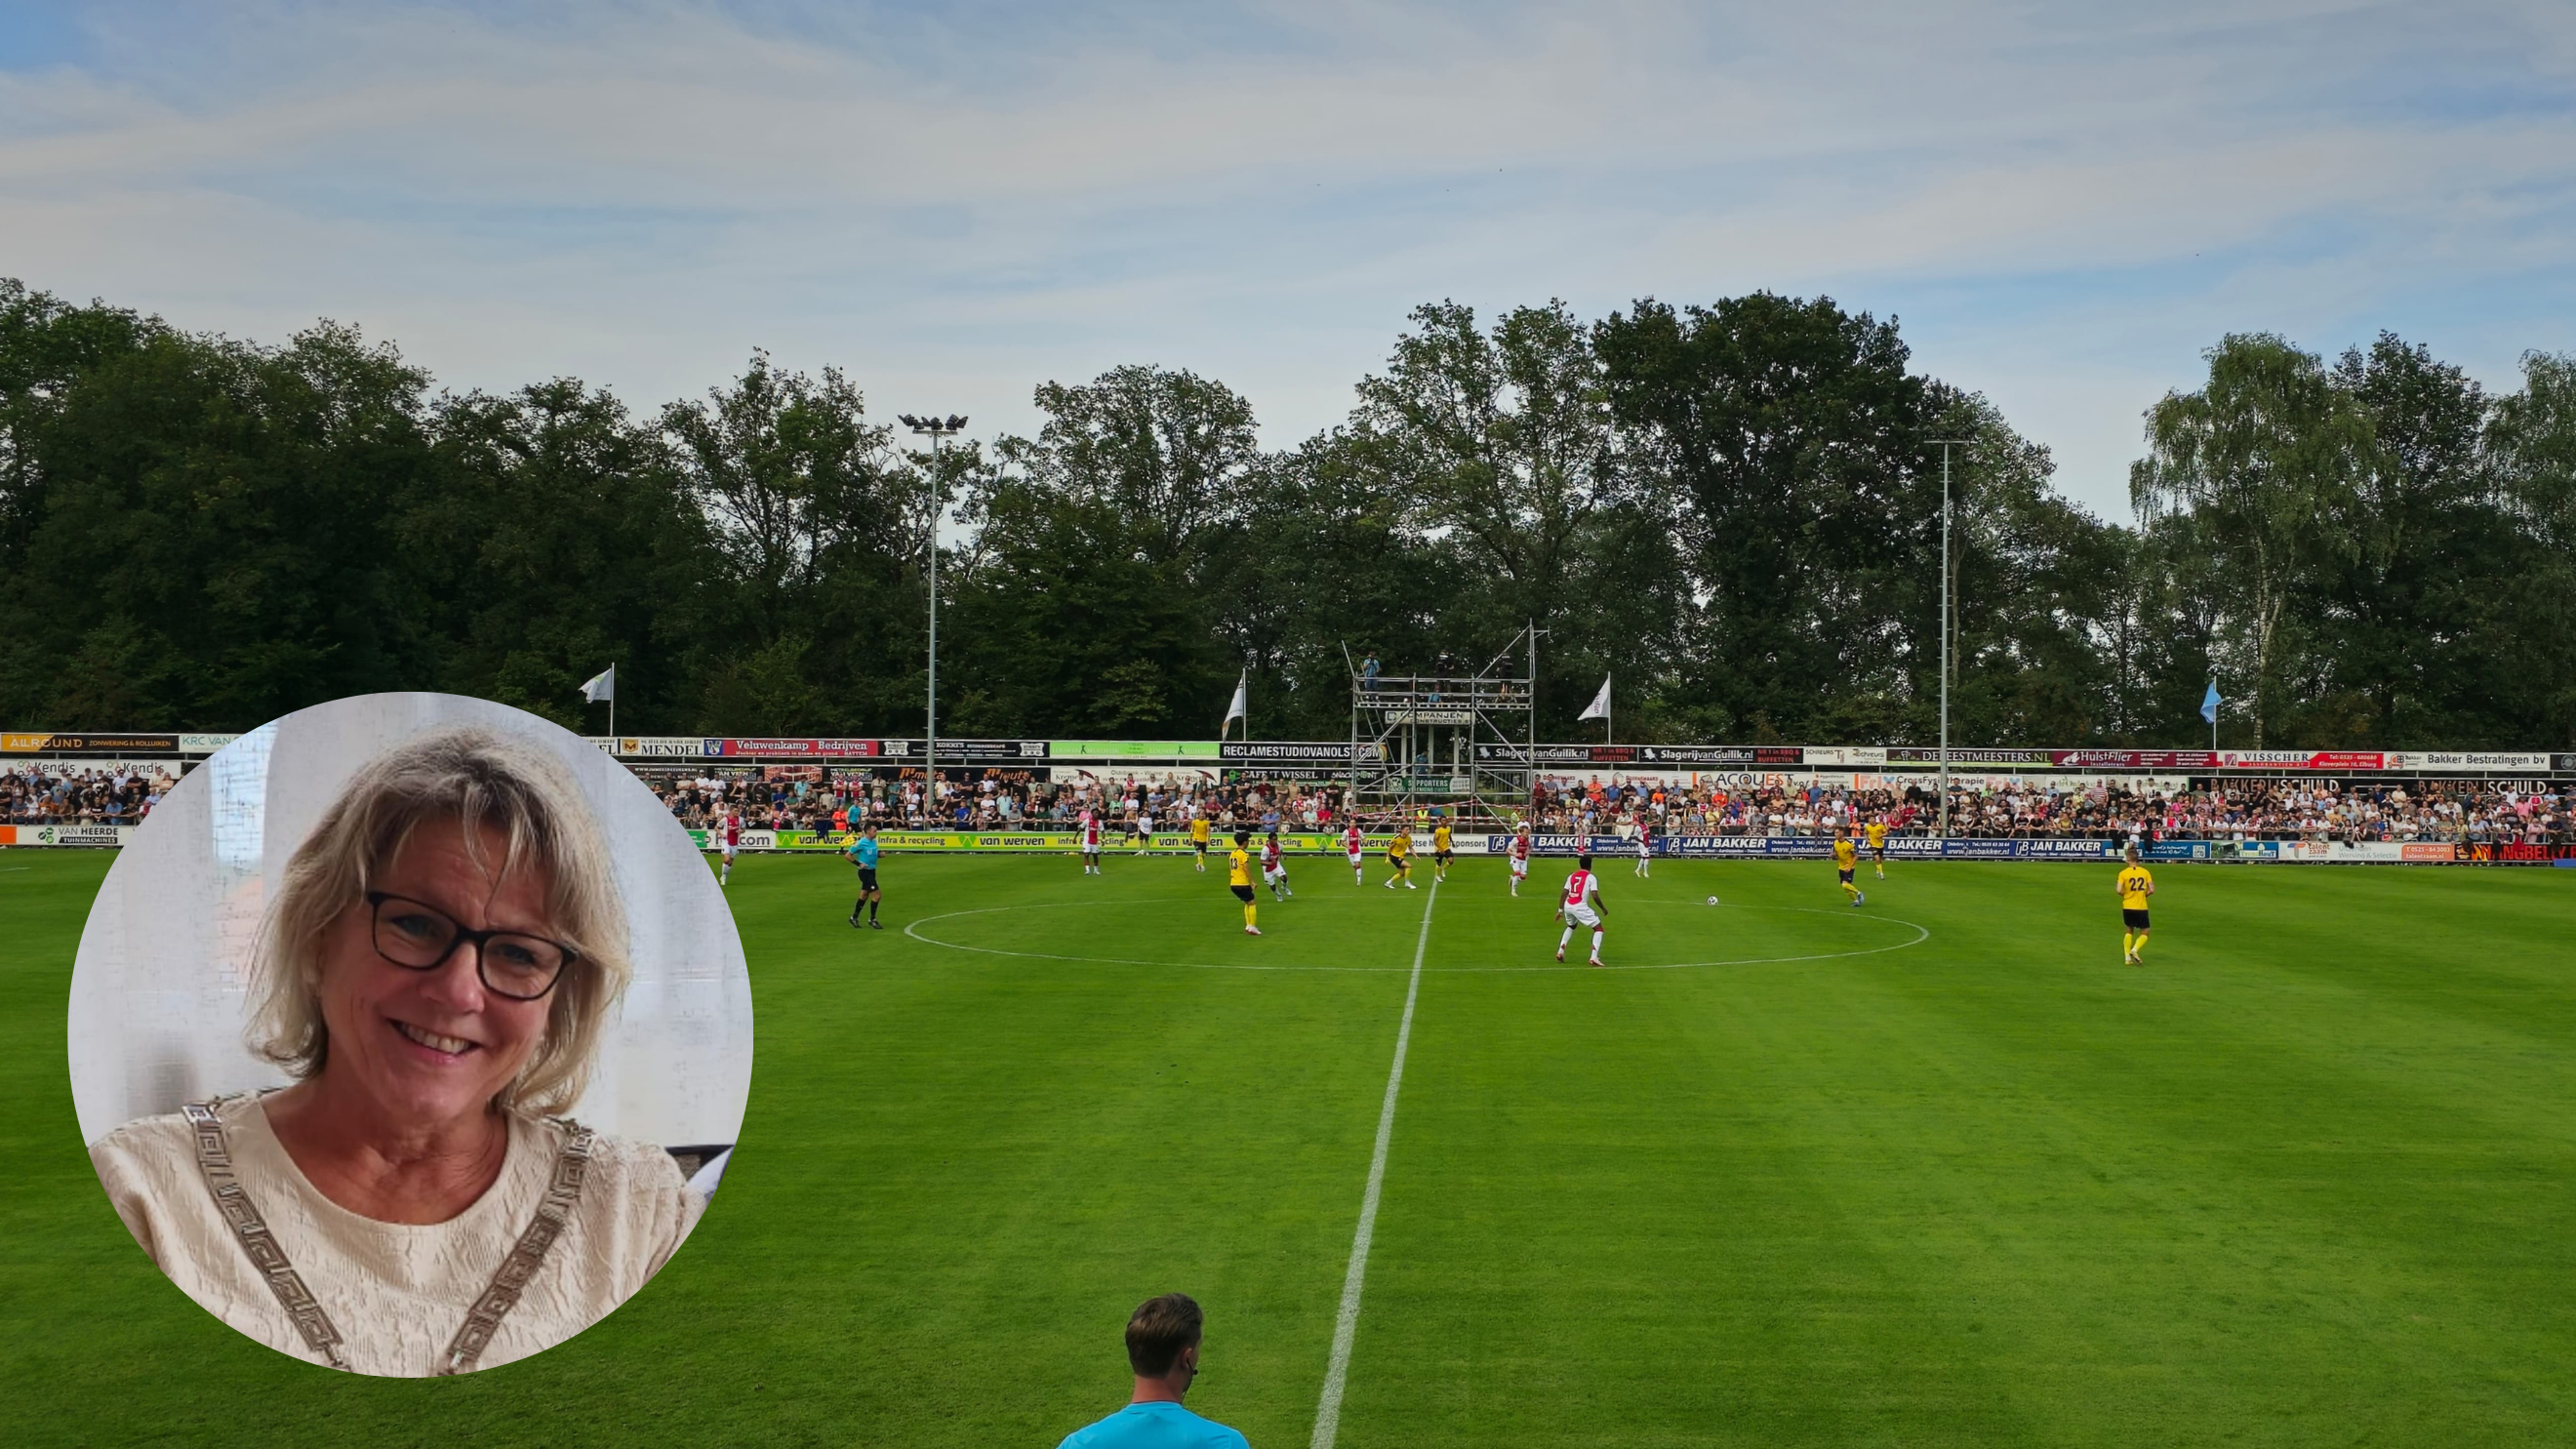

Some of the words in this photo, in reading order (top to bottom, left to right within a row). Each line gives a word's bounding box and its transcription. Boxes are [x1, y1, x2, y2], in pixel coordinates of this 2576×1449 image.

[182, 736, 205, 745] KRC
[641, 745, 703, 755] MENDEL
[736, 741, 809, 751] Veluwenkamp
[818, 741, 867, 751] Bedrijven
[1661, 749, 1753, 761] SlagerijvanGuilik.nl
[1922, 751, 2050, 762] DEEESTMEESTERS.NL
[2244, 753, 2309, 762] VISSCHER
[2428, 754, 2463, 764] Bakker
[2467, 754, 2529, 766] Bestratingen
[2533, 754, 2546, 764] bv
[34, 761, 76, 773] Kendis
[59, 827, 78, 836] VAN
[81, 827, 119, 836] HEERDE
[908, 836, 946, 846] recycling
[1003, 837, 1045, 846] werven
[1683, 838, 1710, 848] JAN
[1712, 838, 1767, 848] BAKKER
[1888, 840, 1942, 850] BAKKER
[2031, 841, 2053, 851] JAN
[2055, 841, 2101, 852] BAKKER
[1574, 876, 1582, 893] 7
[2129, 877, 2145, 891] 22
